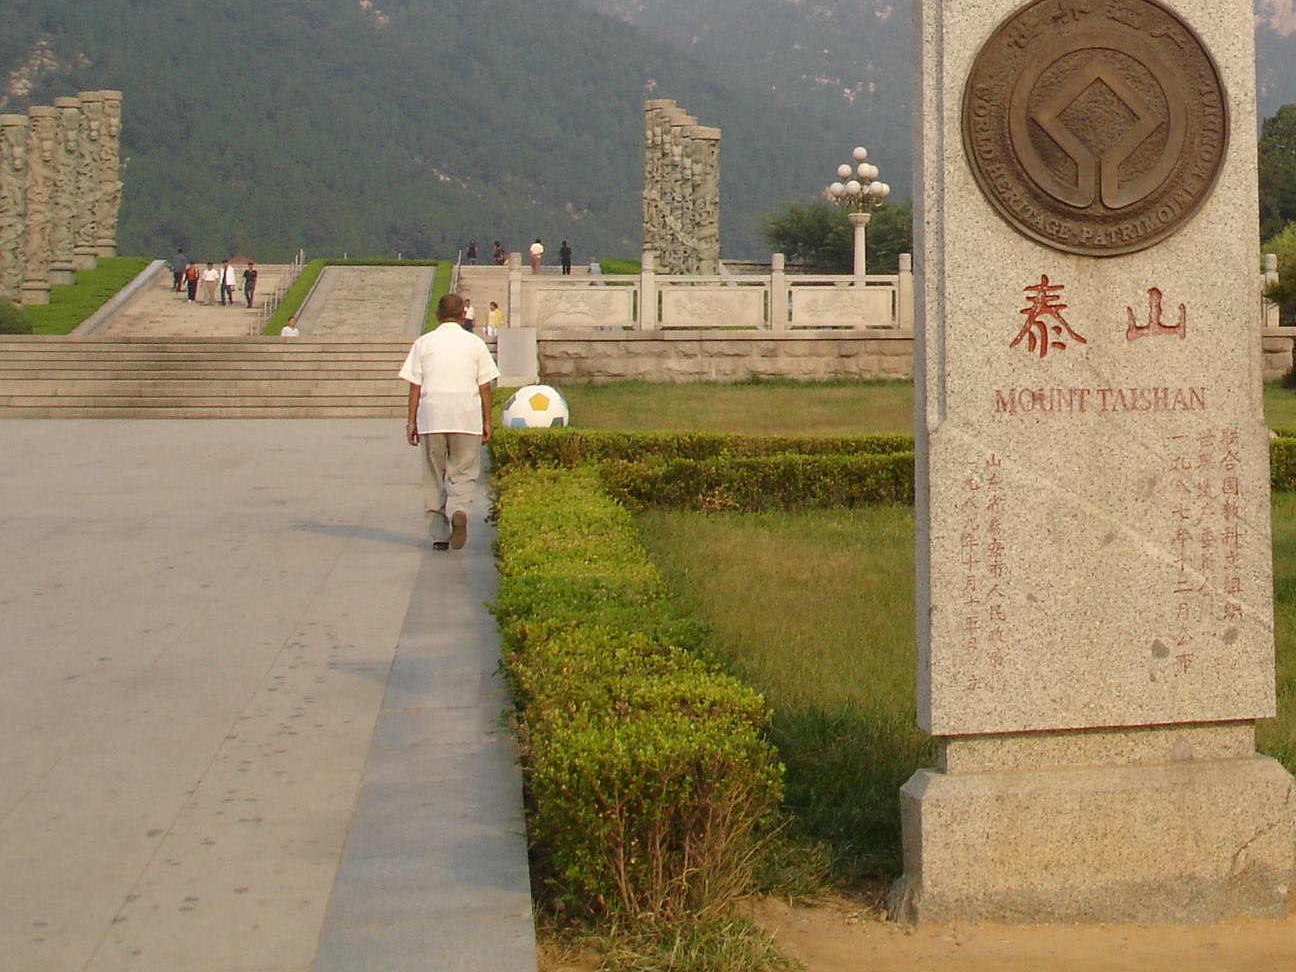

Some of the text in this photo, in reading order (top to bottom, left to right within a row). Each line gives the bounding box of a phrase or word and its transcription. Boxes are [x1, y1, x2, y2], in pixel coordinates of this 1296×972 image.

[973, 84, 1071, 239] WORLD HERITAGE
[1079, 182, 1197, 245] PATRIMOINE
[1009, 273, 1187, 359] 泰山
[995, 386, 1207, 413] MOUNT TAISHAN
